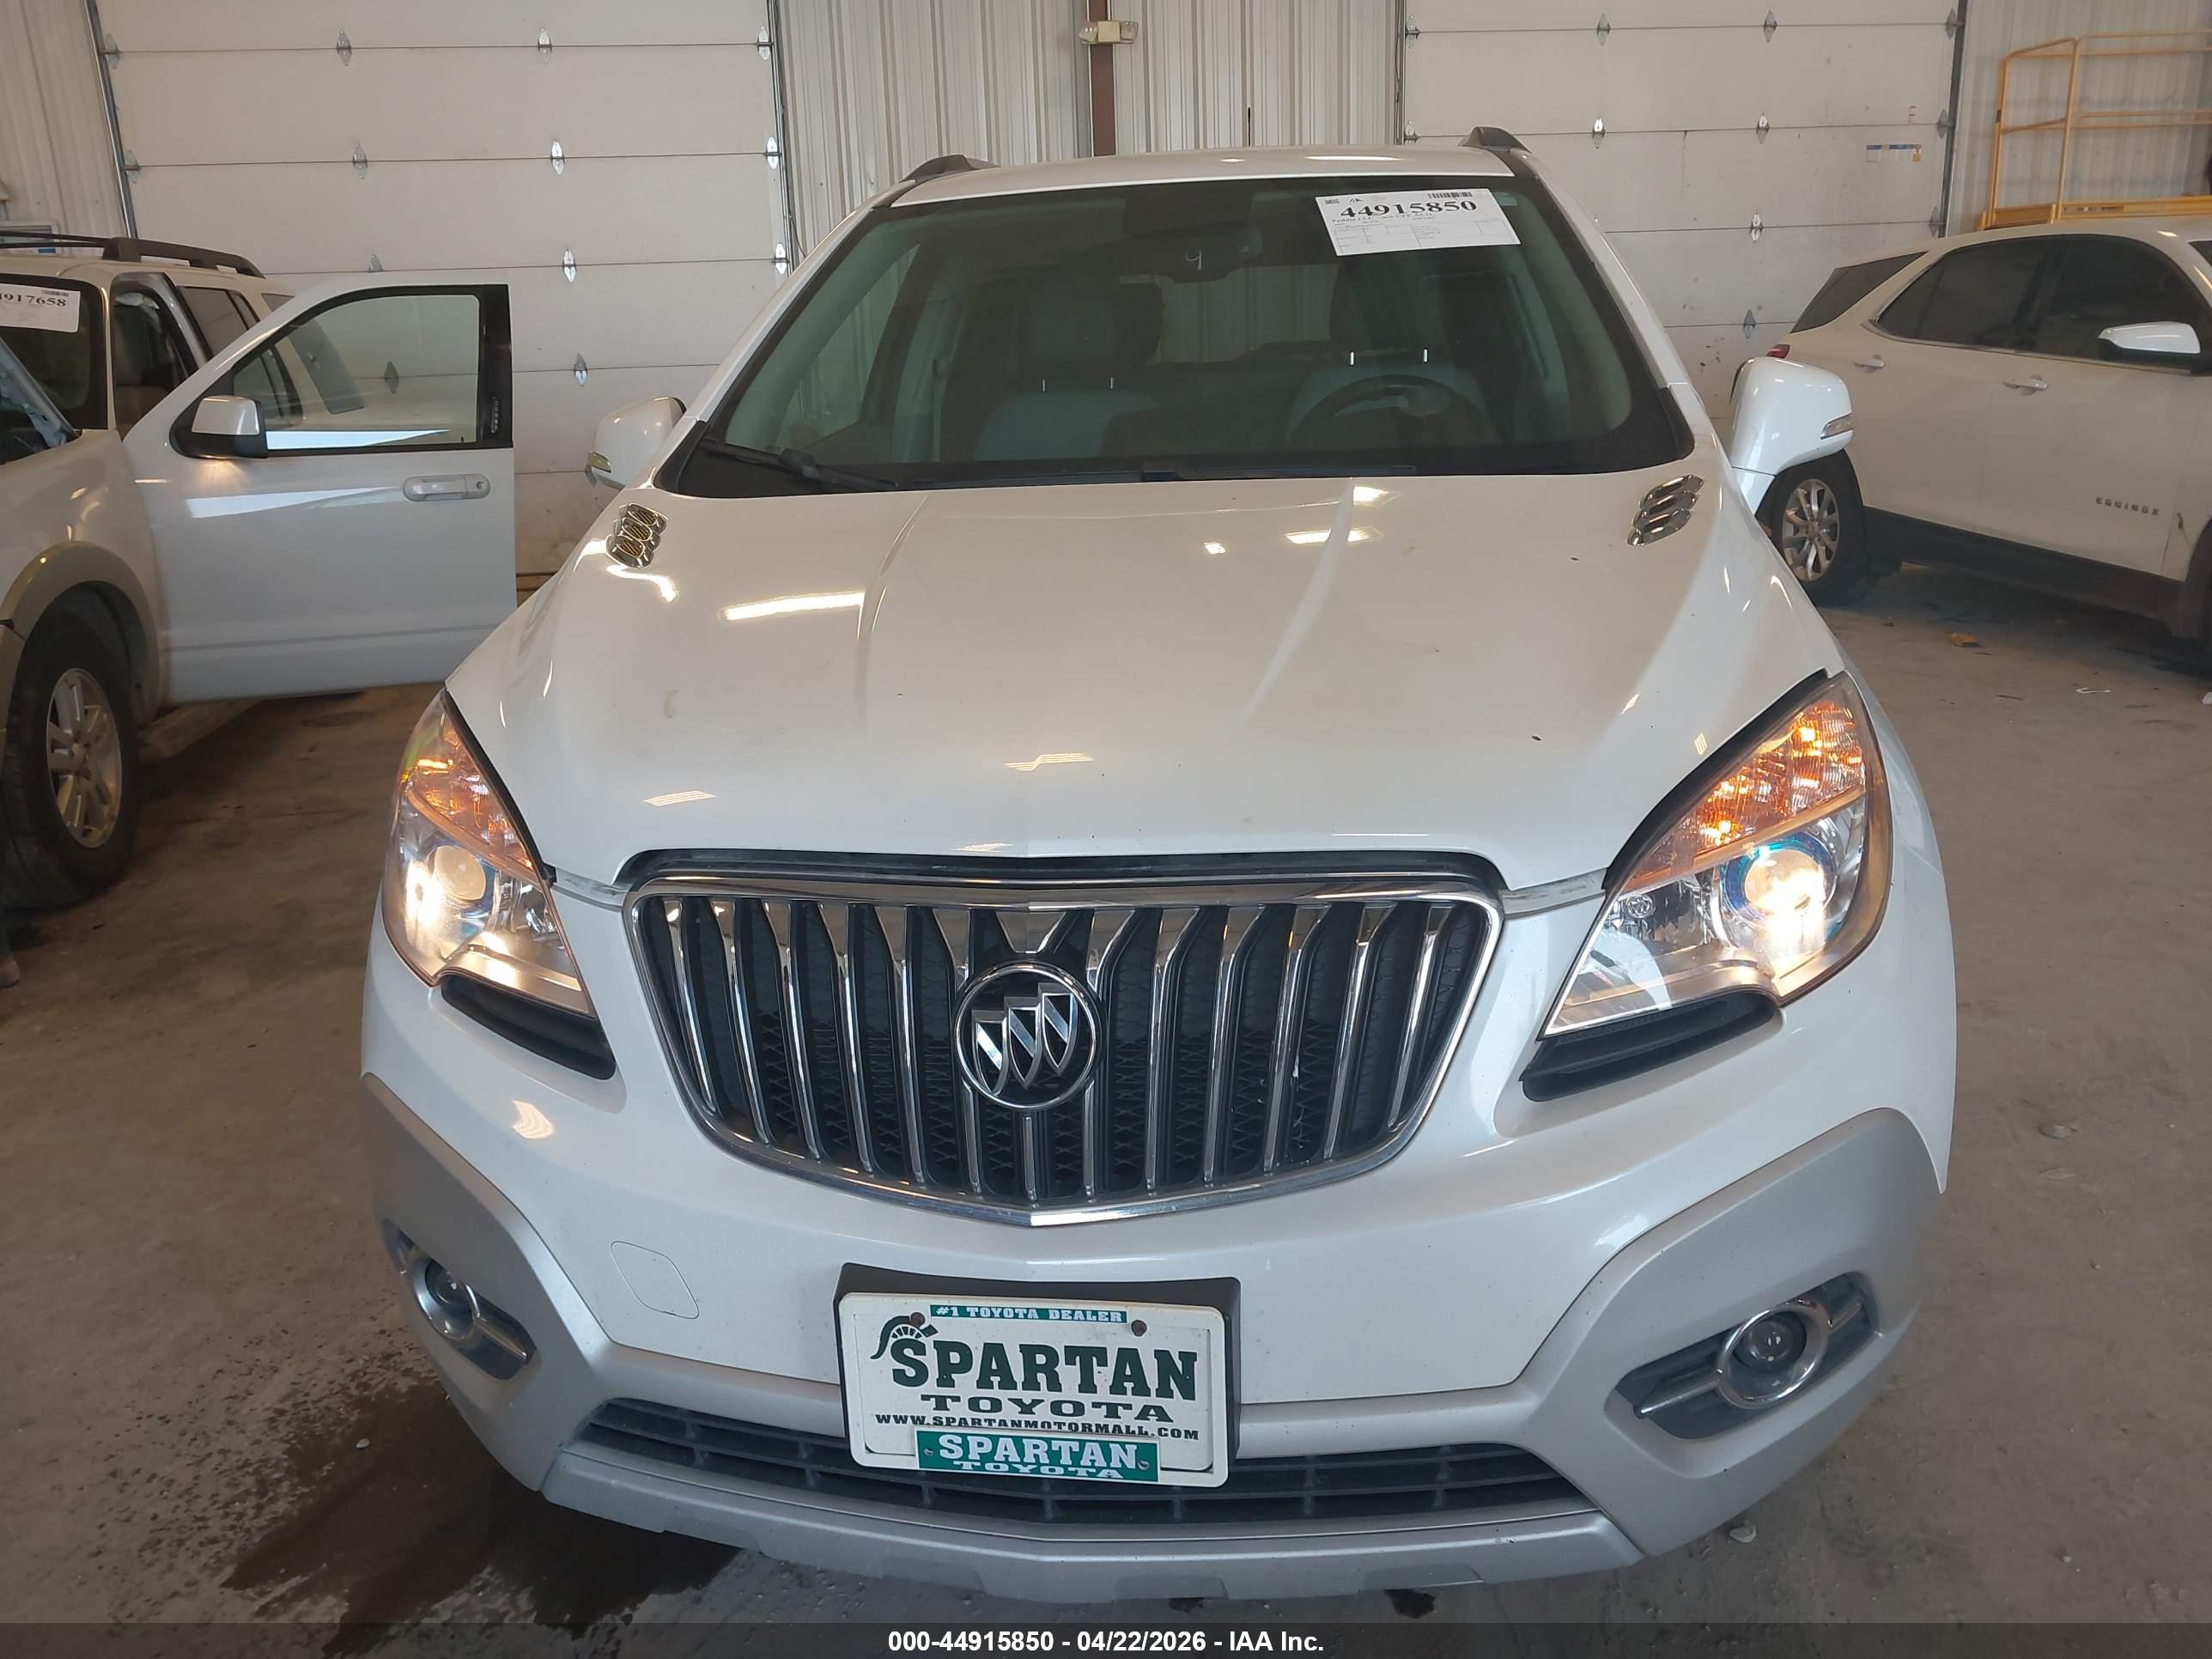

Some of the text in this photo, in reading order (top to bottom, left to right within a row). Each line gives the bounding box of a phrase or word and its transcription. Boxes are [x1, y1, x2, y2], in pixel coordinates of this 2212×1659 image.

[1340, 201, 1477, 217] 44915850
[0, 293, 67, 307] 917658
[2096, 496, 2159, 515] EQUINOX
[936, 1305, 1123, 1322] #1 TOYOTA DEALER
[890, 1338, 1198, 1401] SPARTAN
[921, 1394, 1174, 1423] TOYOTA
[939, 1433, 1138, 1469] SPARTAN
[953, 1461, 1124, 1479] TOYOTA
